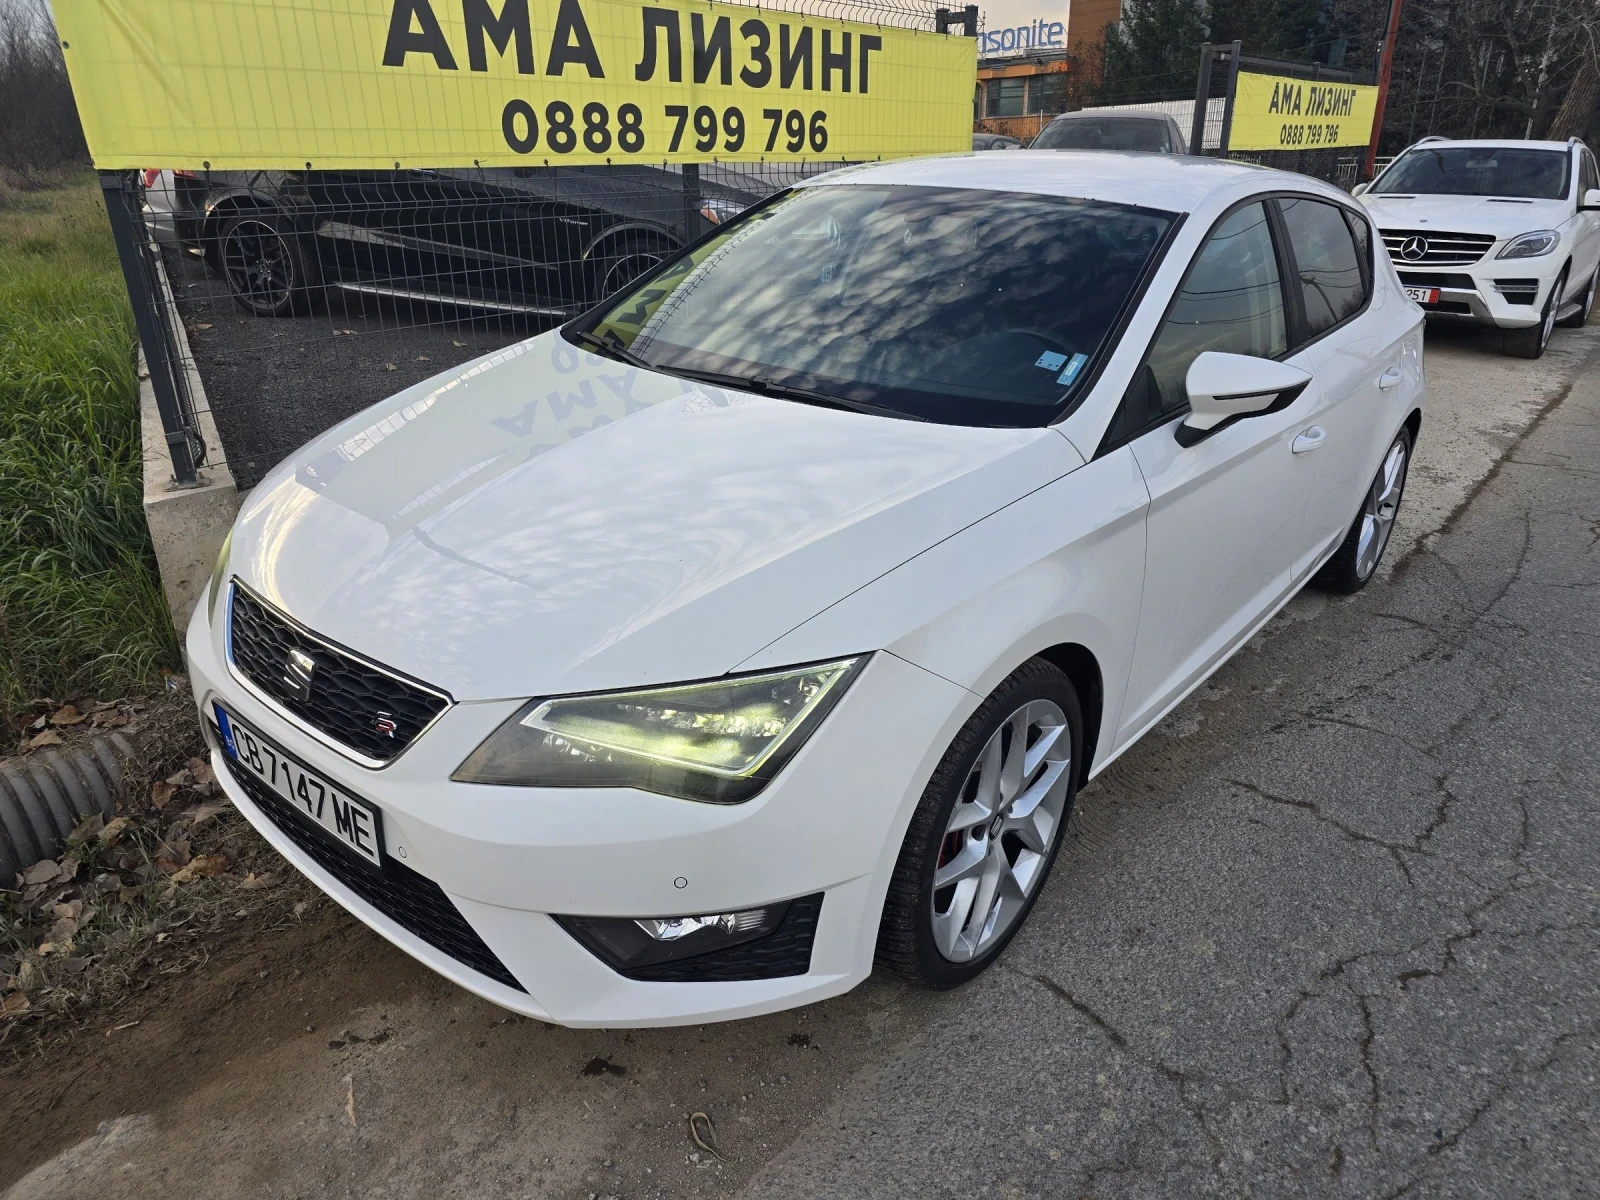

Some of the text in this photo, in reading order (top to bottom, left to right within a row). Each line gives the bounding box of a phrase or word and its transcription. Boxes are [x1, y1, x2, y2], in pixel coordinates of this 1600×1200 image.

[382, 0, 882, 94] АМА ЛИЗИНГ
[1268, 82, 1357, 116] АМА ЛИЗИНГ
[502, 99, 828, 154] 0888 799 796
[1280, 124, 1339, 145] 0888 799 796
